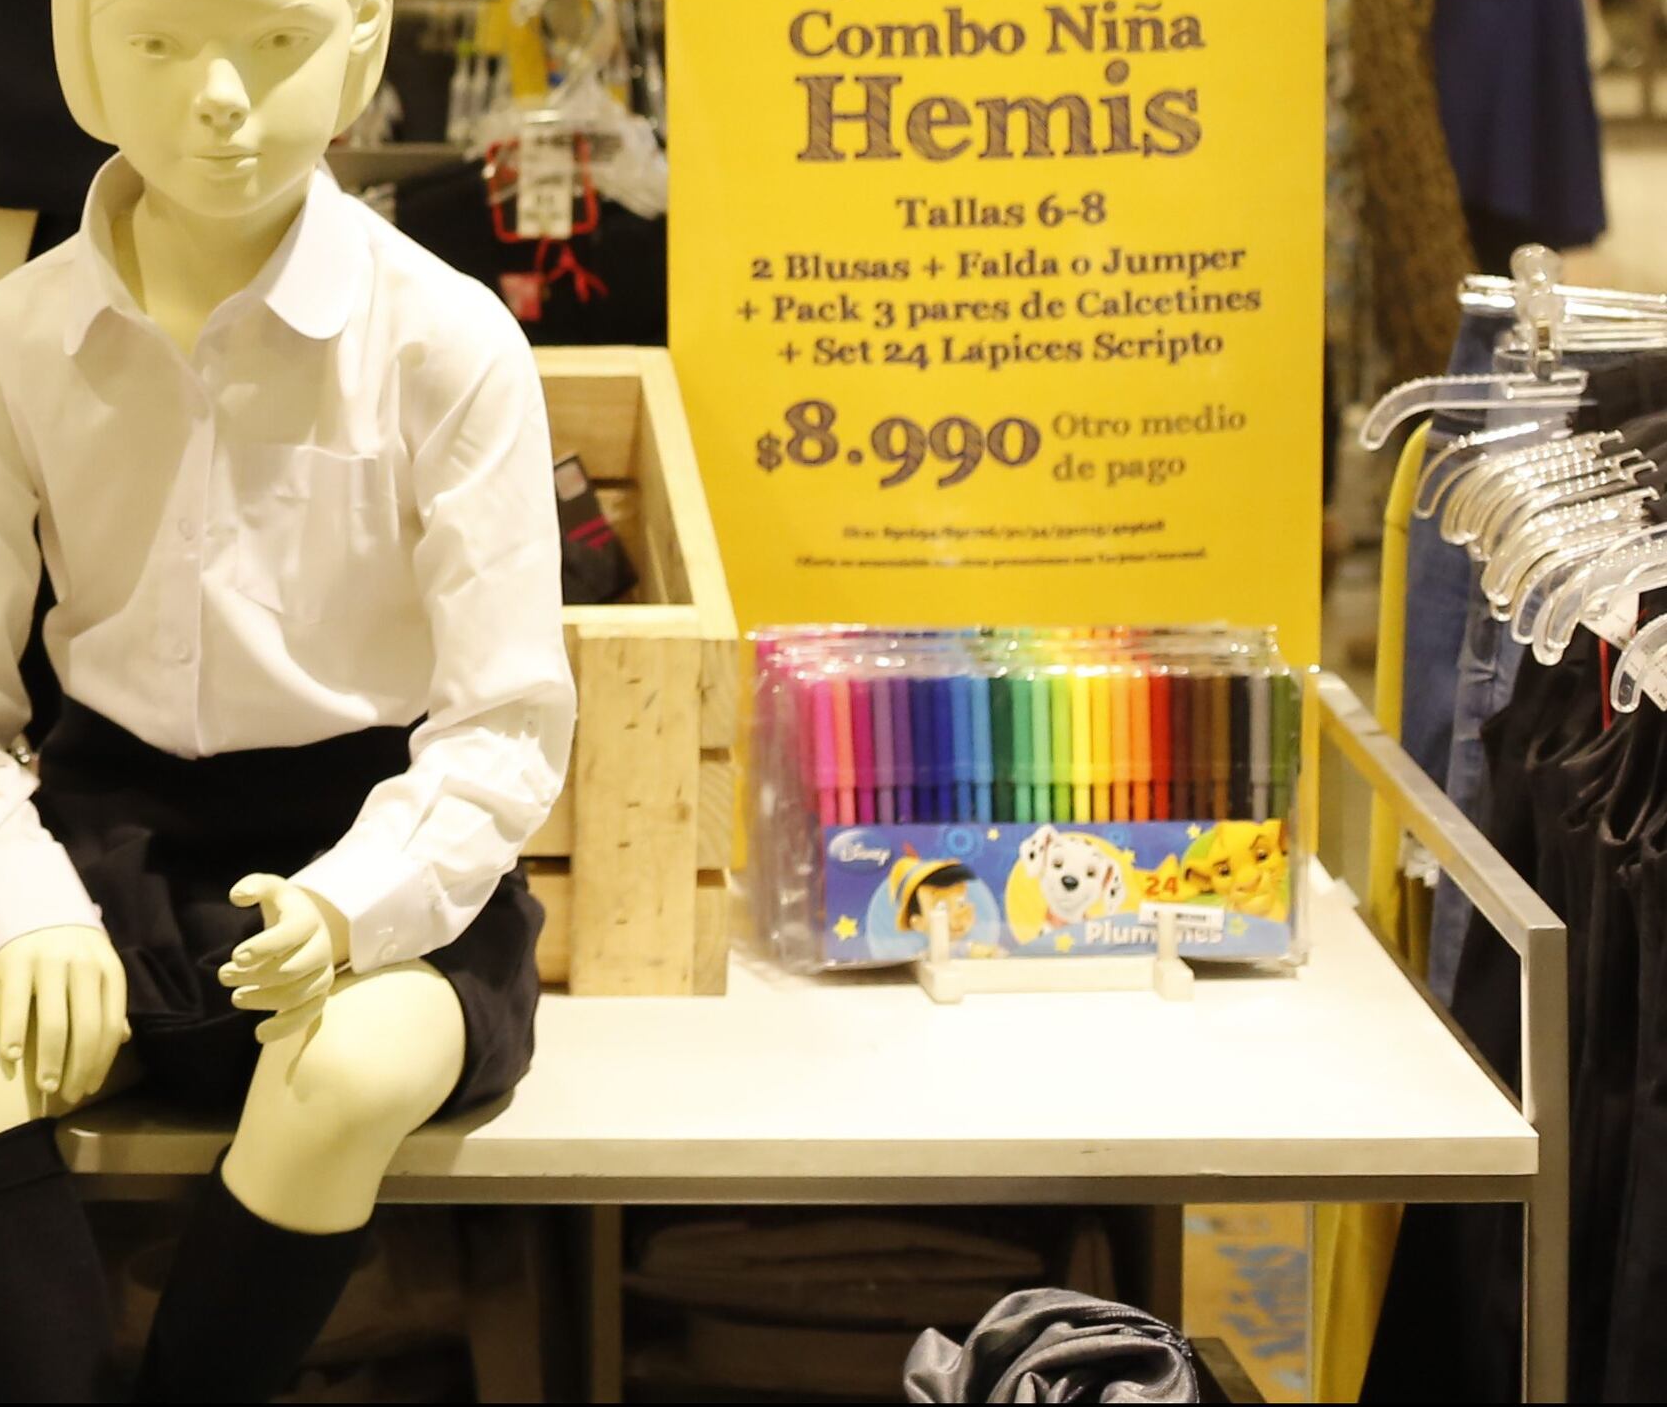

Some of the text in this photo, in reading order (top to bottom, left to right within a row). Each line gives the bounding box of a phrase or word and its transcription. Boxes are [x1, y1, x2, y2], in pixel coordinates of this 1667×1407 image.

[788, 6, 1024, 60] Combo
[795, 61, 1202, 162] Hemis
[896, 192, 1106, 229] Tallas 6-8
[751, 259, 773, 279] 2
[786, 254, 909, 281] Blusas
[959, 251, 1058, 278] Falda
[1072, 257, 1089, 275] o
[1102, 247, 1246, 279] Jumper
[773, 296, 859, 323] Pack
[874, 303, 896, 329] 3
[907, 300, 1009, 329] pares
[1020, 291, 1065, 319] de
[1075, 286, 1261, 317] Calcetines
[813, 337, 871, 363] Set
[883, 344, 929, 370] 24
[1093, 330, 1224, 366] Scripto
[1052, 406, 1247, 438] Otro medio
[756, 400, 1041, 489] $8.990
[1052, 456, 1187, 486] de pago
[1144, 876, 1178, 896] 24
[1085, 921, 1222, 945] Plumnes
